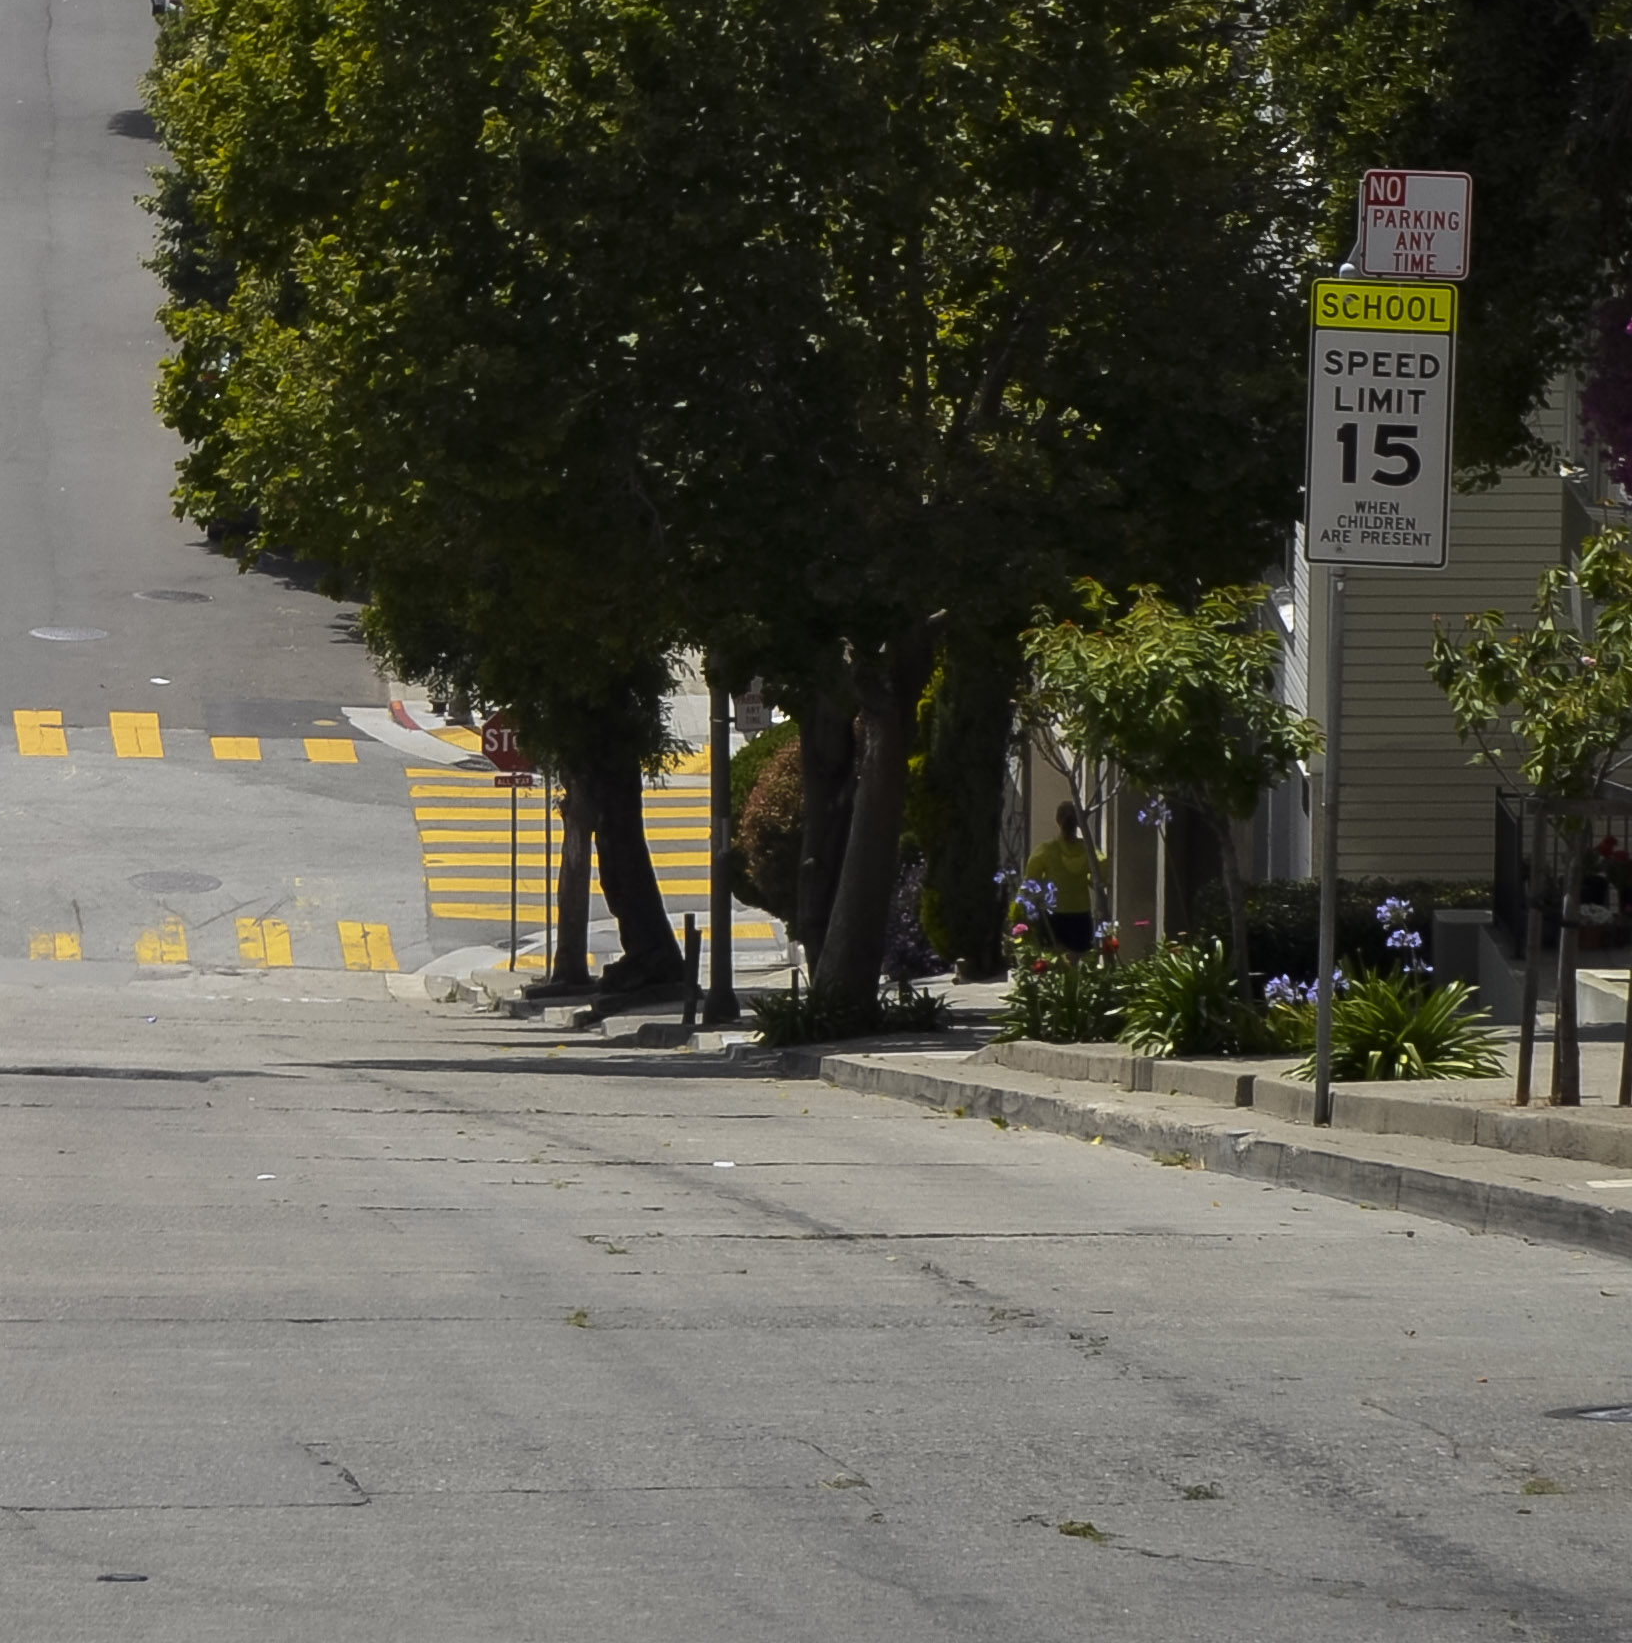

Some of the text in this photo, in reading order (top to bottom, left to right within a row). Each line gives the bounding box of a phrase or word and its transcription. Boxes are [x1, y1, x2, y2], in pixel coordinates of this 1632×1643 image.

[1370, 176, 1402, 202] NO
[1373, 209, 1460, 231] PARKING
[1395, 232, 1436, 252] ANY
[1393, 253, 1437, 273] TIME
[1321, 292, 1446, 323] SCHOOL
[1323, 350, 1441, 380] SPEED
[1334, 386, 1427, 415] LIMIT
[1336, 422, 1422, 487] 15
[1355, 501, 1400, 516] WHEN
[1337, 515, 1416, 531] CHILDREN
[1320, 529, 1433, 547] ARE PRESENT
